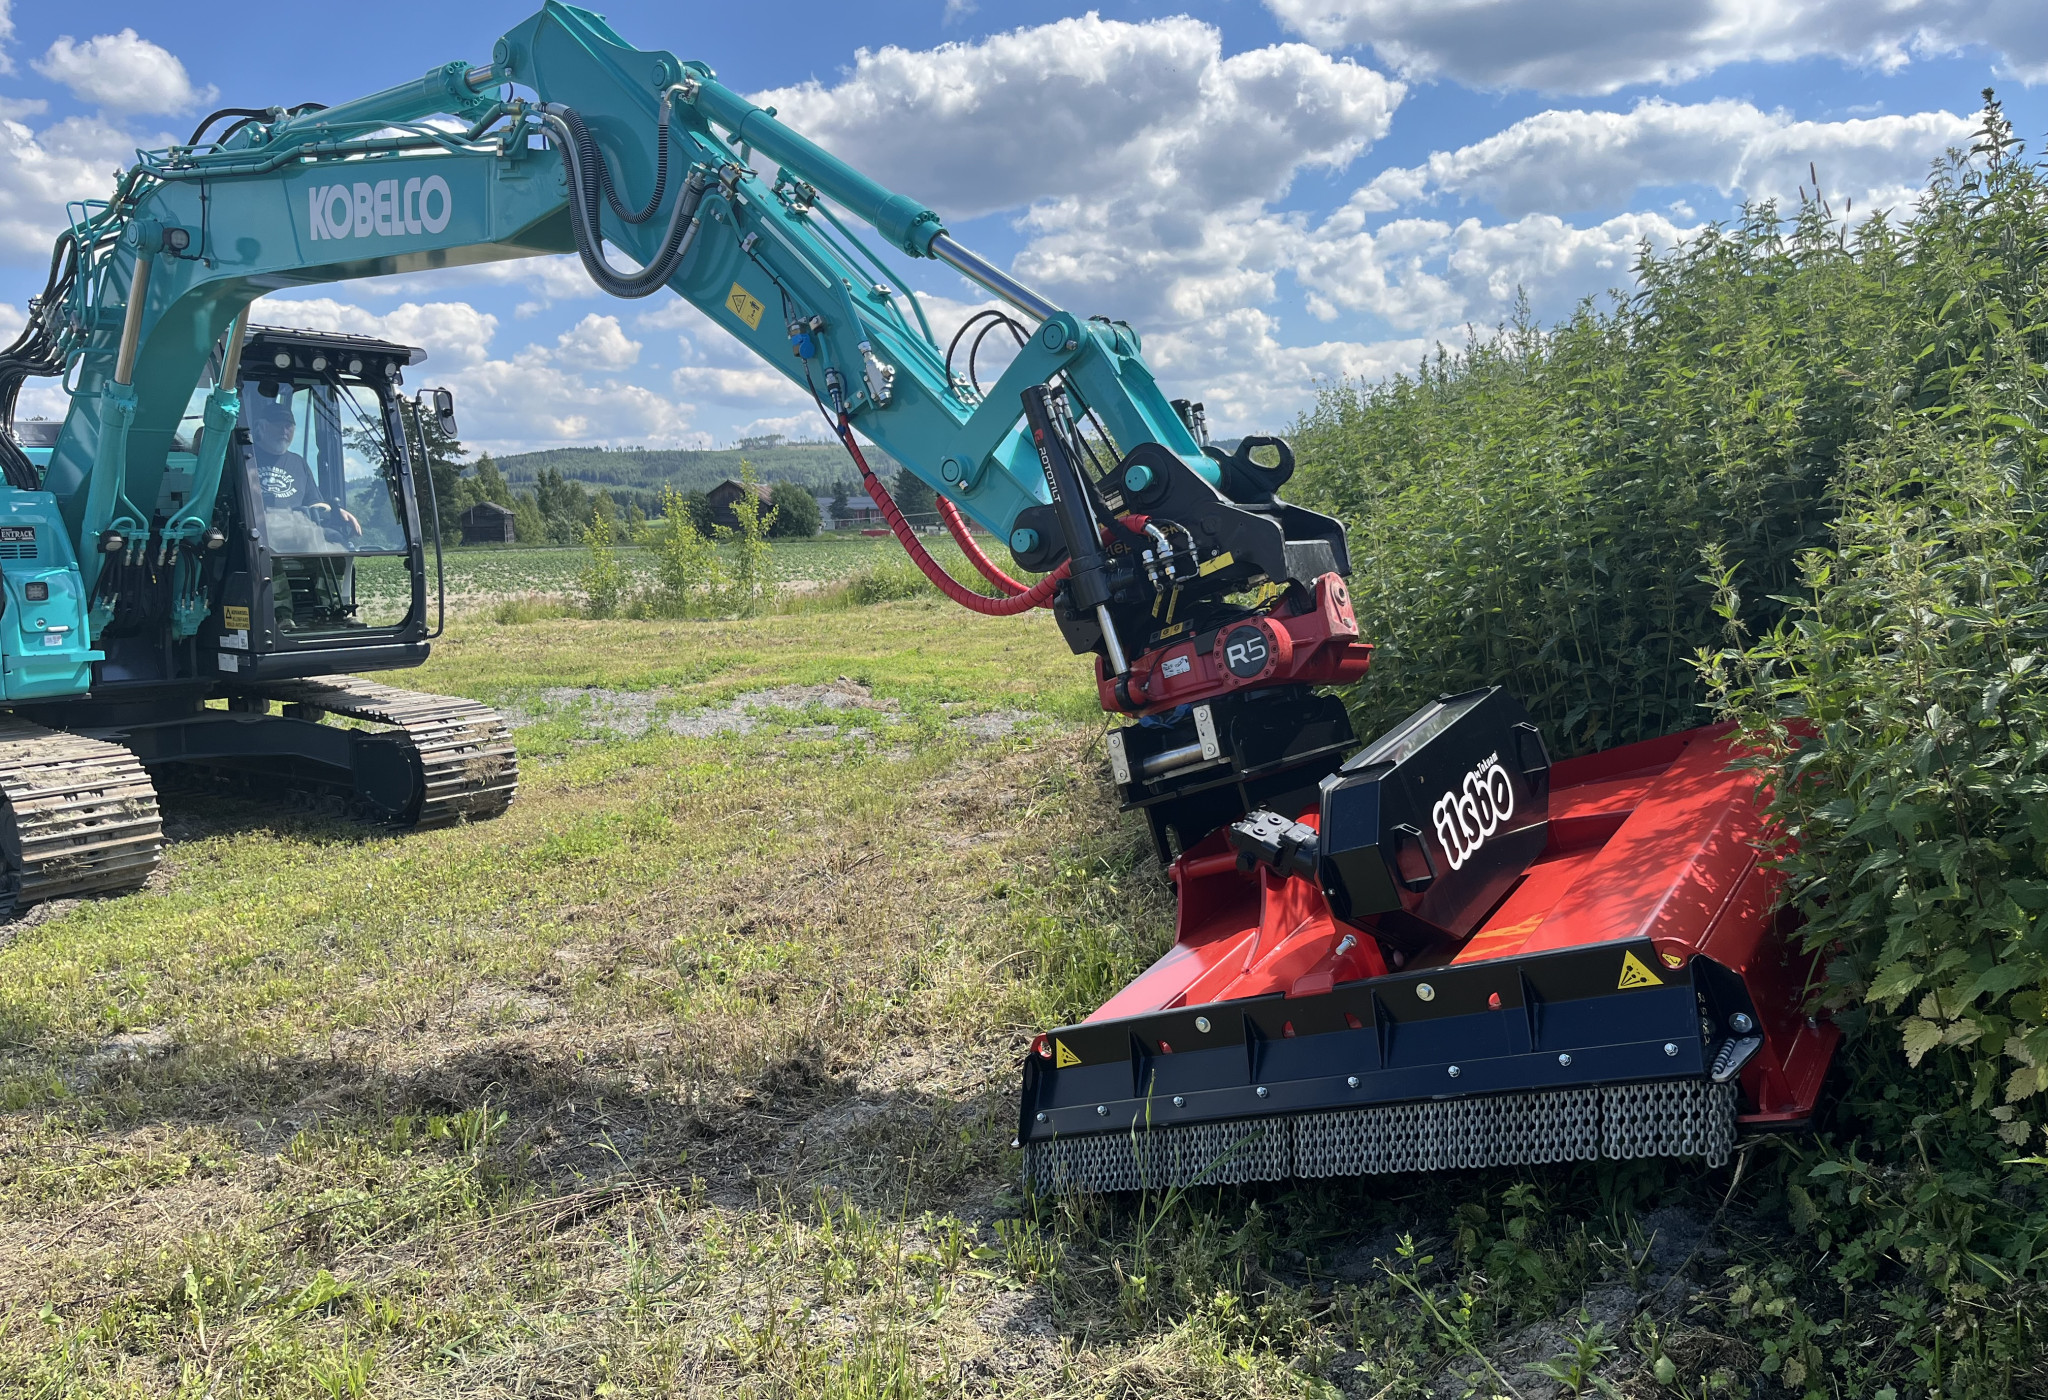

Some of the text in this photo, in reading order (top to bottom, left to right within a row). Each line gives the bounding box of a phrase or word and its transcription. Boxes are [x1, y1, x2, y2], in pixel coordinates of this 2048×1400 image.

[309, 175, 452, 240] KOBELCO
[1039, 446, 1062, 503] ROTOTILT
[1226, 636, 1266, 669] R5
[1433, 764, 1514, 870] ilsbo
